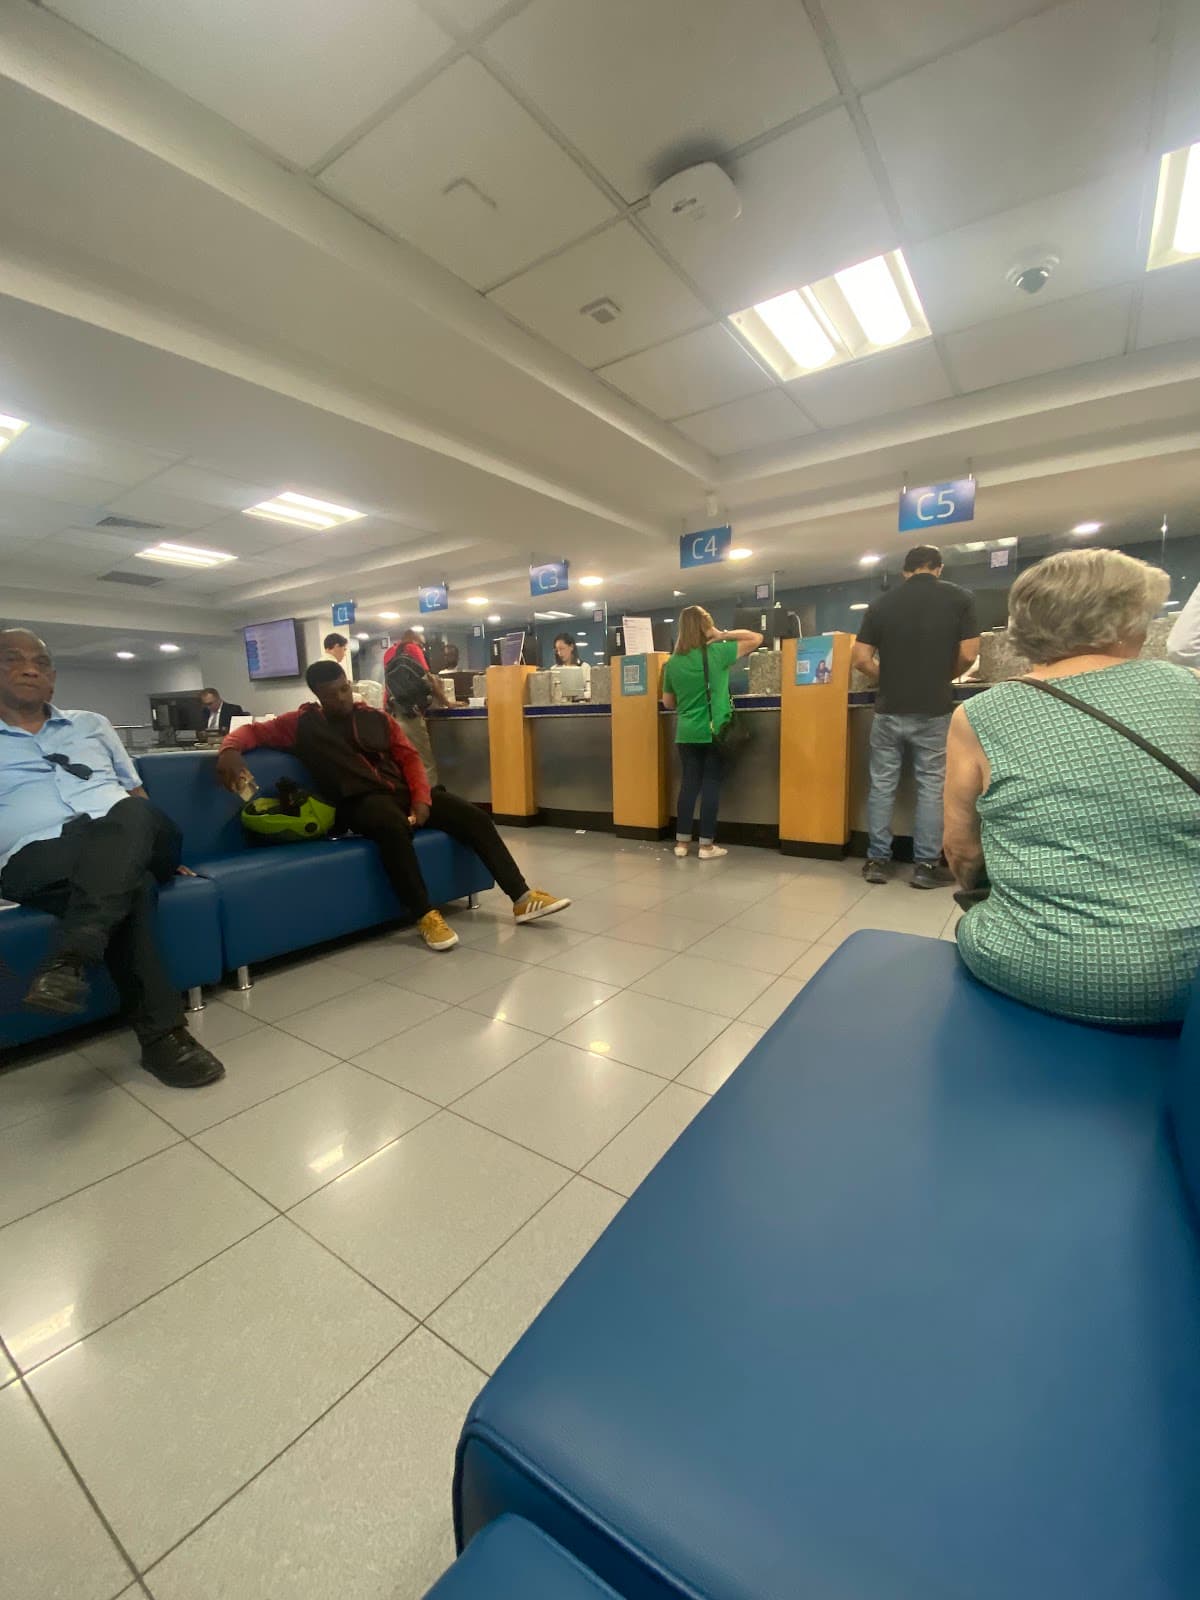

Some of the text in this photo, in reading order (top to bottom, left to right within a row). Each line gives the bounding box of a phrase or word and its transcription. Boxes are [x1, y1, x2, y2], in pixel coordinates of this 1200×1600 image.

[916, 489, 955, 520] C5
[692, 536, 718, 559] C4
[539, 568, 558, 590] C3
[425, 590, 441, 608] C2
[337, 607, 350, 622] C1
